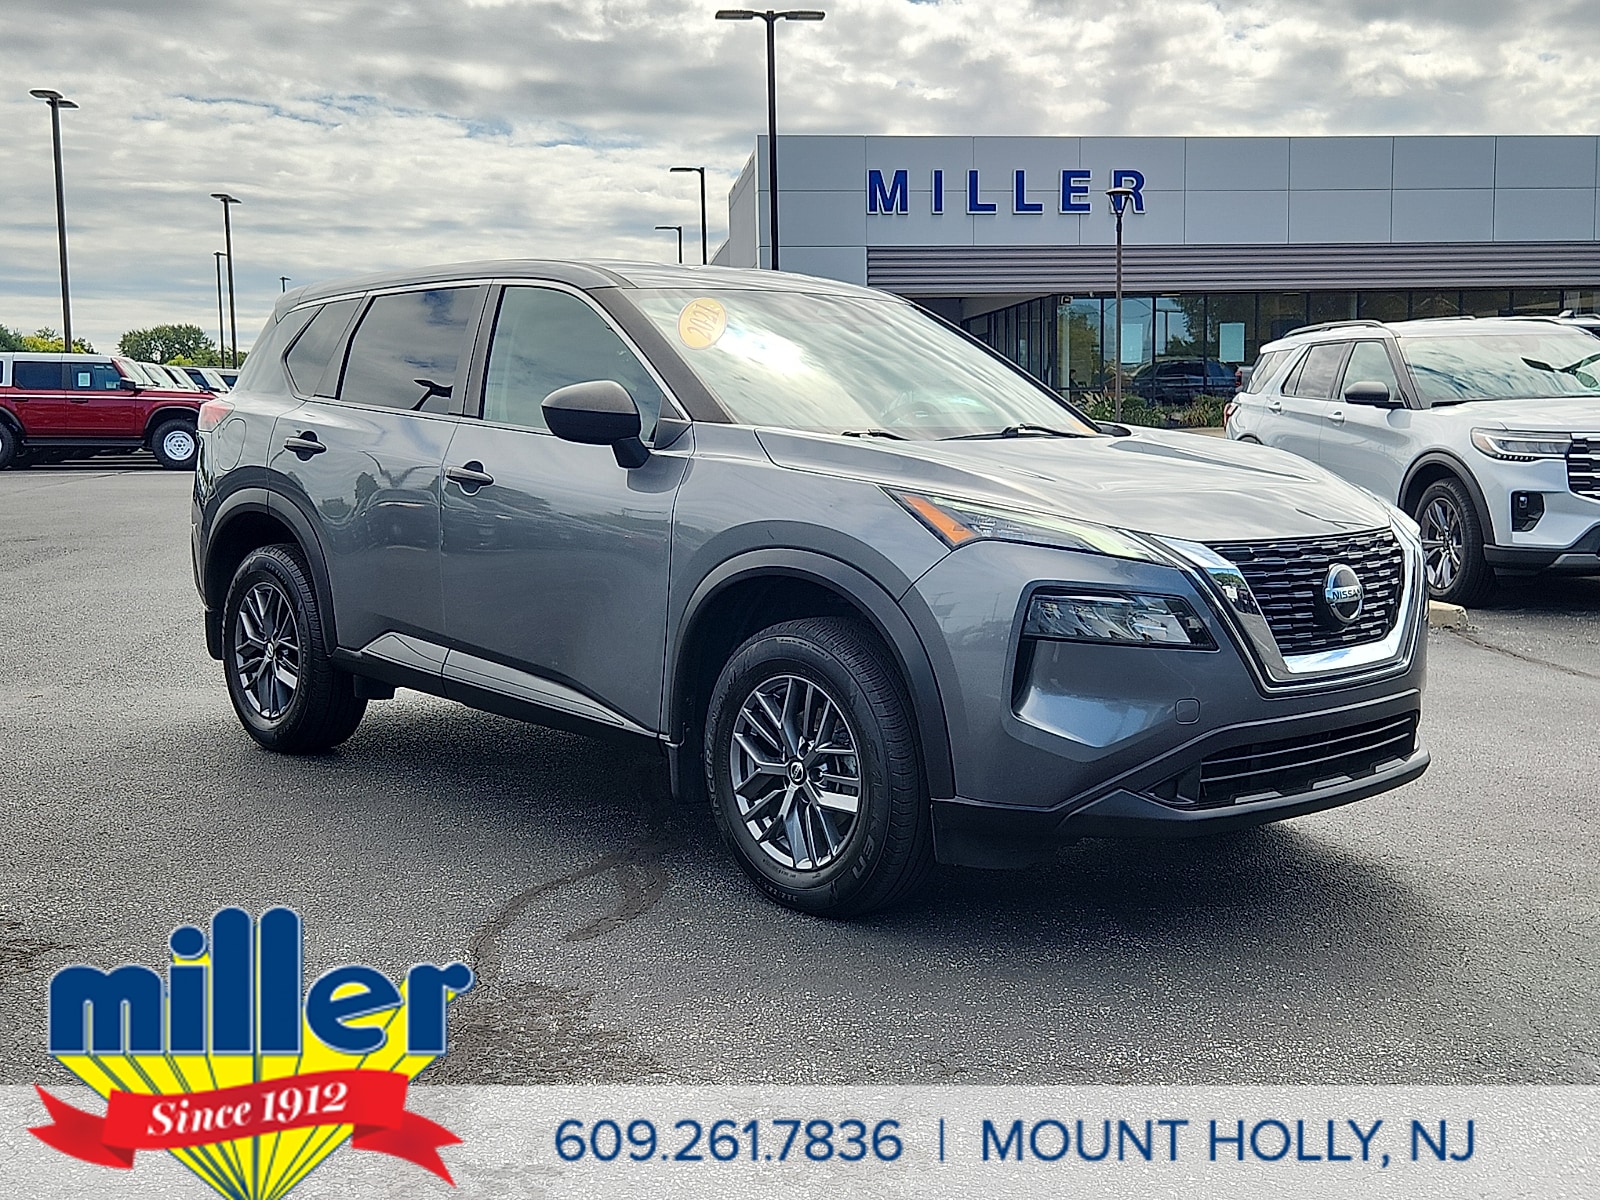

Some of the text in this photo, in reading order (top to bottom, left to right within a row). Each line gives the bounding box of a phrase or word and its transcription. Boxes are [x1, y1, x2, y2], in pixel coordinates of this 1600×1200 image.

[866, 169, 1146, 214] MILLER
[687, 303, 720, 341] 2021
[1332, 588, 1361, 600] NISSAN
